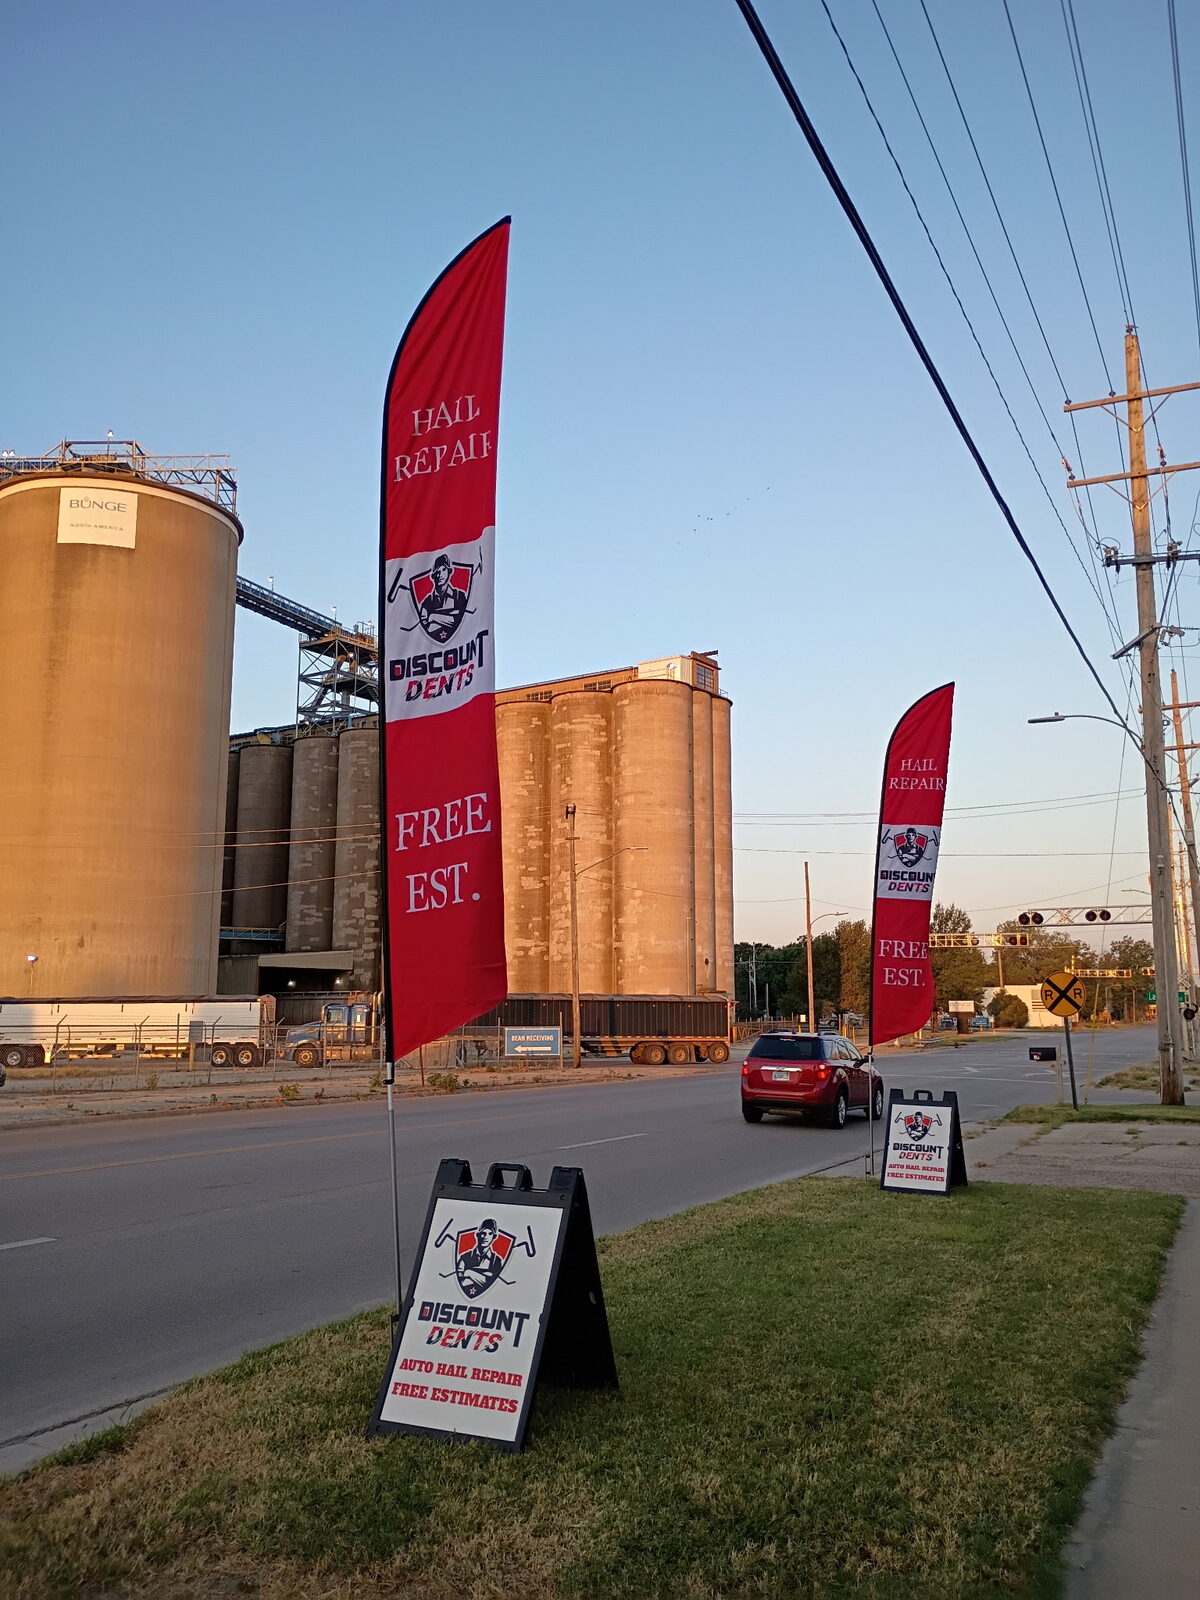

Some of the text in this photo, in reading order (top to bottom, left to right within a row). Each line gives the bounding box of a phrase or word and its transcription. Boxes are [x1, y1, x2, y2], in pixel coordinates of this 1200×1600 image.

[412, 395, 480, 436] HAIL
[69, 499, 127, 513] BUNGE
[389, 630, 489, 681] DISCOUNT
[404, 663, 475, 702] DENTS
[900, 758, 938, 772] HAIL
[889, 776, 945, 791] REPAIR
[395, 792, 492, 852] FREE
[405, 861, 481, 914] EST.
[888, 881, 930, 893] DENTS
[878, 939, 929, 959] FREE
[883, 967, 926, 987] EST.
[511, 1034, 554, 1042] BEAN RECEIVING
[892, 1142, 944, 1159] DISCOUNT
[898, 1151, 934, 1162] DENTS
[904, 1174, 945, 1183] ESTIMATES
[417, 1300, 531, 1348] DISCOUNT
[426, 1325, 505, 1353] DENTS
[399, 1358, 523, 1387] AUTO HAIL REPAIR
[391, 1381, 519, 1414] FREE ESTIMATES
